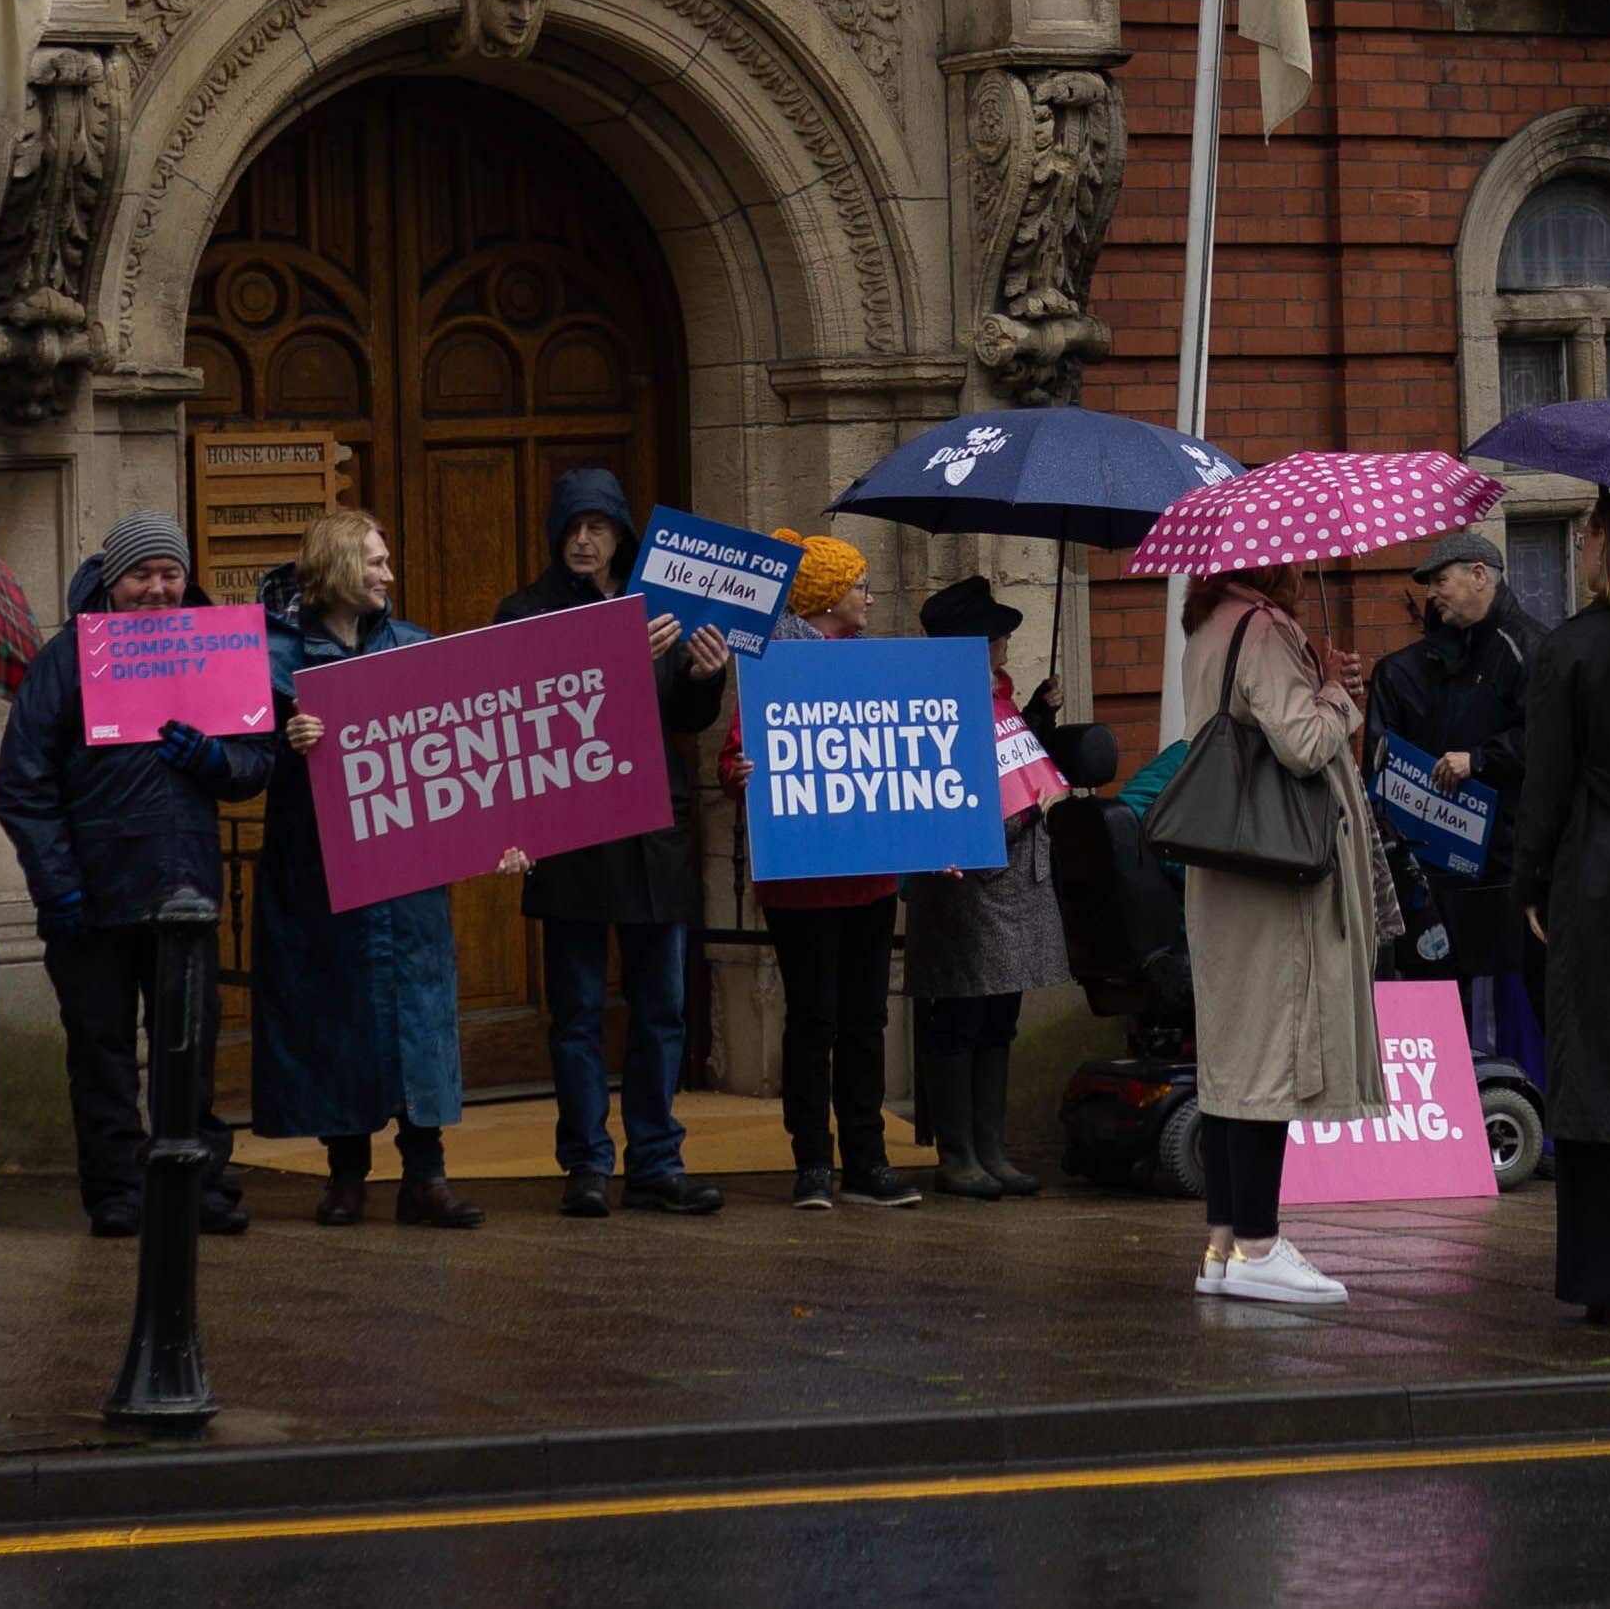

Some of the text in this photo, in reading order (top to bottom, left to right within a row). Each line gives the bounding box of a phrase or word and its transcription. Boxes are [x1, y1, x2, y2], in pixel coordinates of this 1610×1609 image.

[207, 445, 324, 464] HOUSE OF KEY
[655, 529, 789, 578] CAMPAIGN FOR
[664, 561, 757, 601] Isle of Man
[108, 615, 195, 637] CHOICE
[110, 634, 260, 657] COMPASSION
[112, 657, 207, 680] DIGNITY
[339, 668, 605, 750] CAMPAIGN FOR
[765, 698, 959, 726] CAMPAIGN FOR
[342, 693, 605, 797] DIGNITY
[766, 724, 959, 771] DIGNITY
[349, 740, 633, 842] IN DYING.
[770, 768, 978, 816] IN DYING.
[1390, 780, 1467, 832] Isle of Man
[1458, 792, 1489, 816] FOR
[1384, 1038, 1436, 1060] FOR
